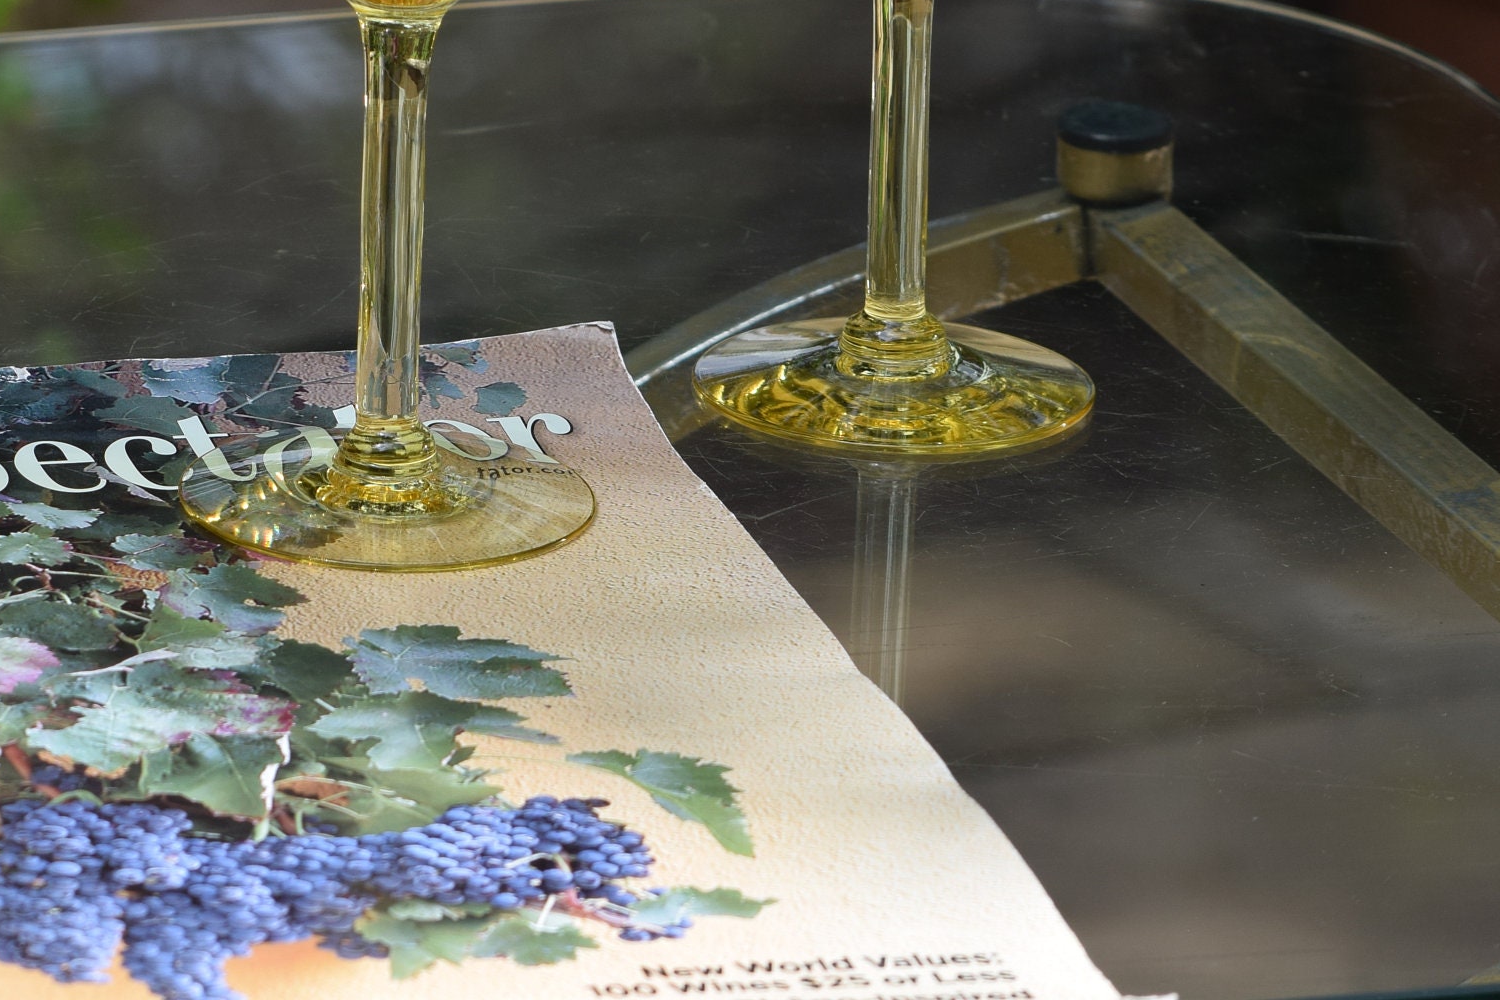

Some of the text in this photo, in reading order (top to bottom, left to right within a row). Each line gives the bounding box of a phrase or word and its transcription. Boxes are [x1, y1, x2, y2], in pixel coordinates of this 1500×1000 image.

[641, 952, 1003, 978] New World Values:
[589, 981, 658, 997] 100
[668, 980, 791, 994] Wines
[800, 974, 871, 991] $25
[883, 974, 919, 986] or
[931, 970, 1017, 983] Less
